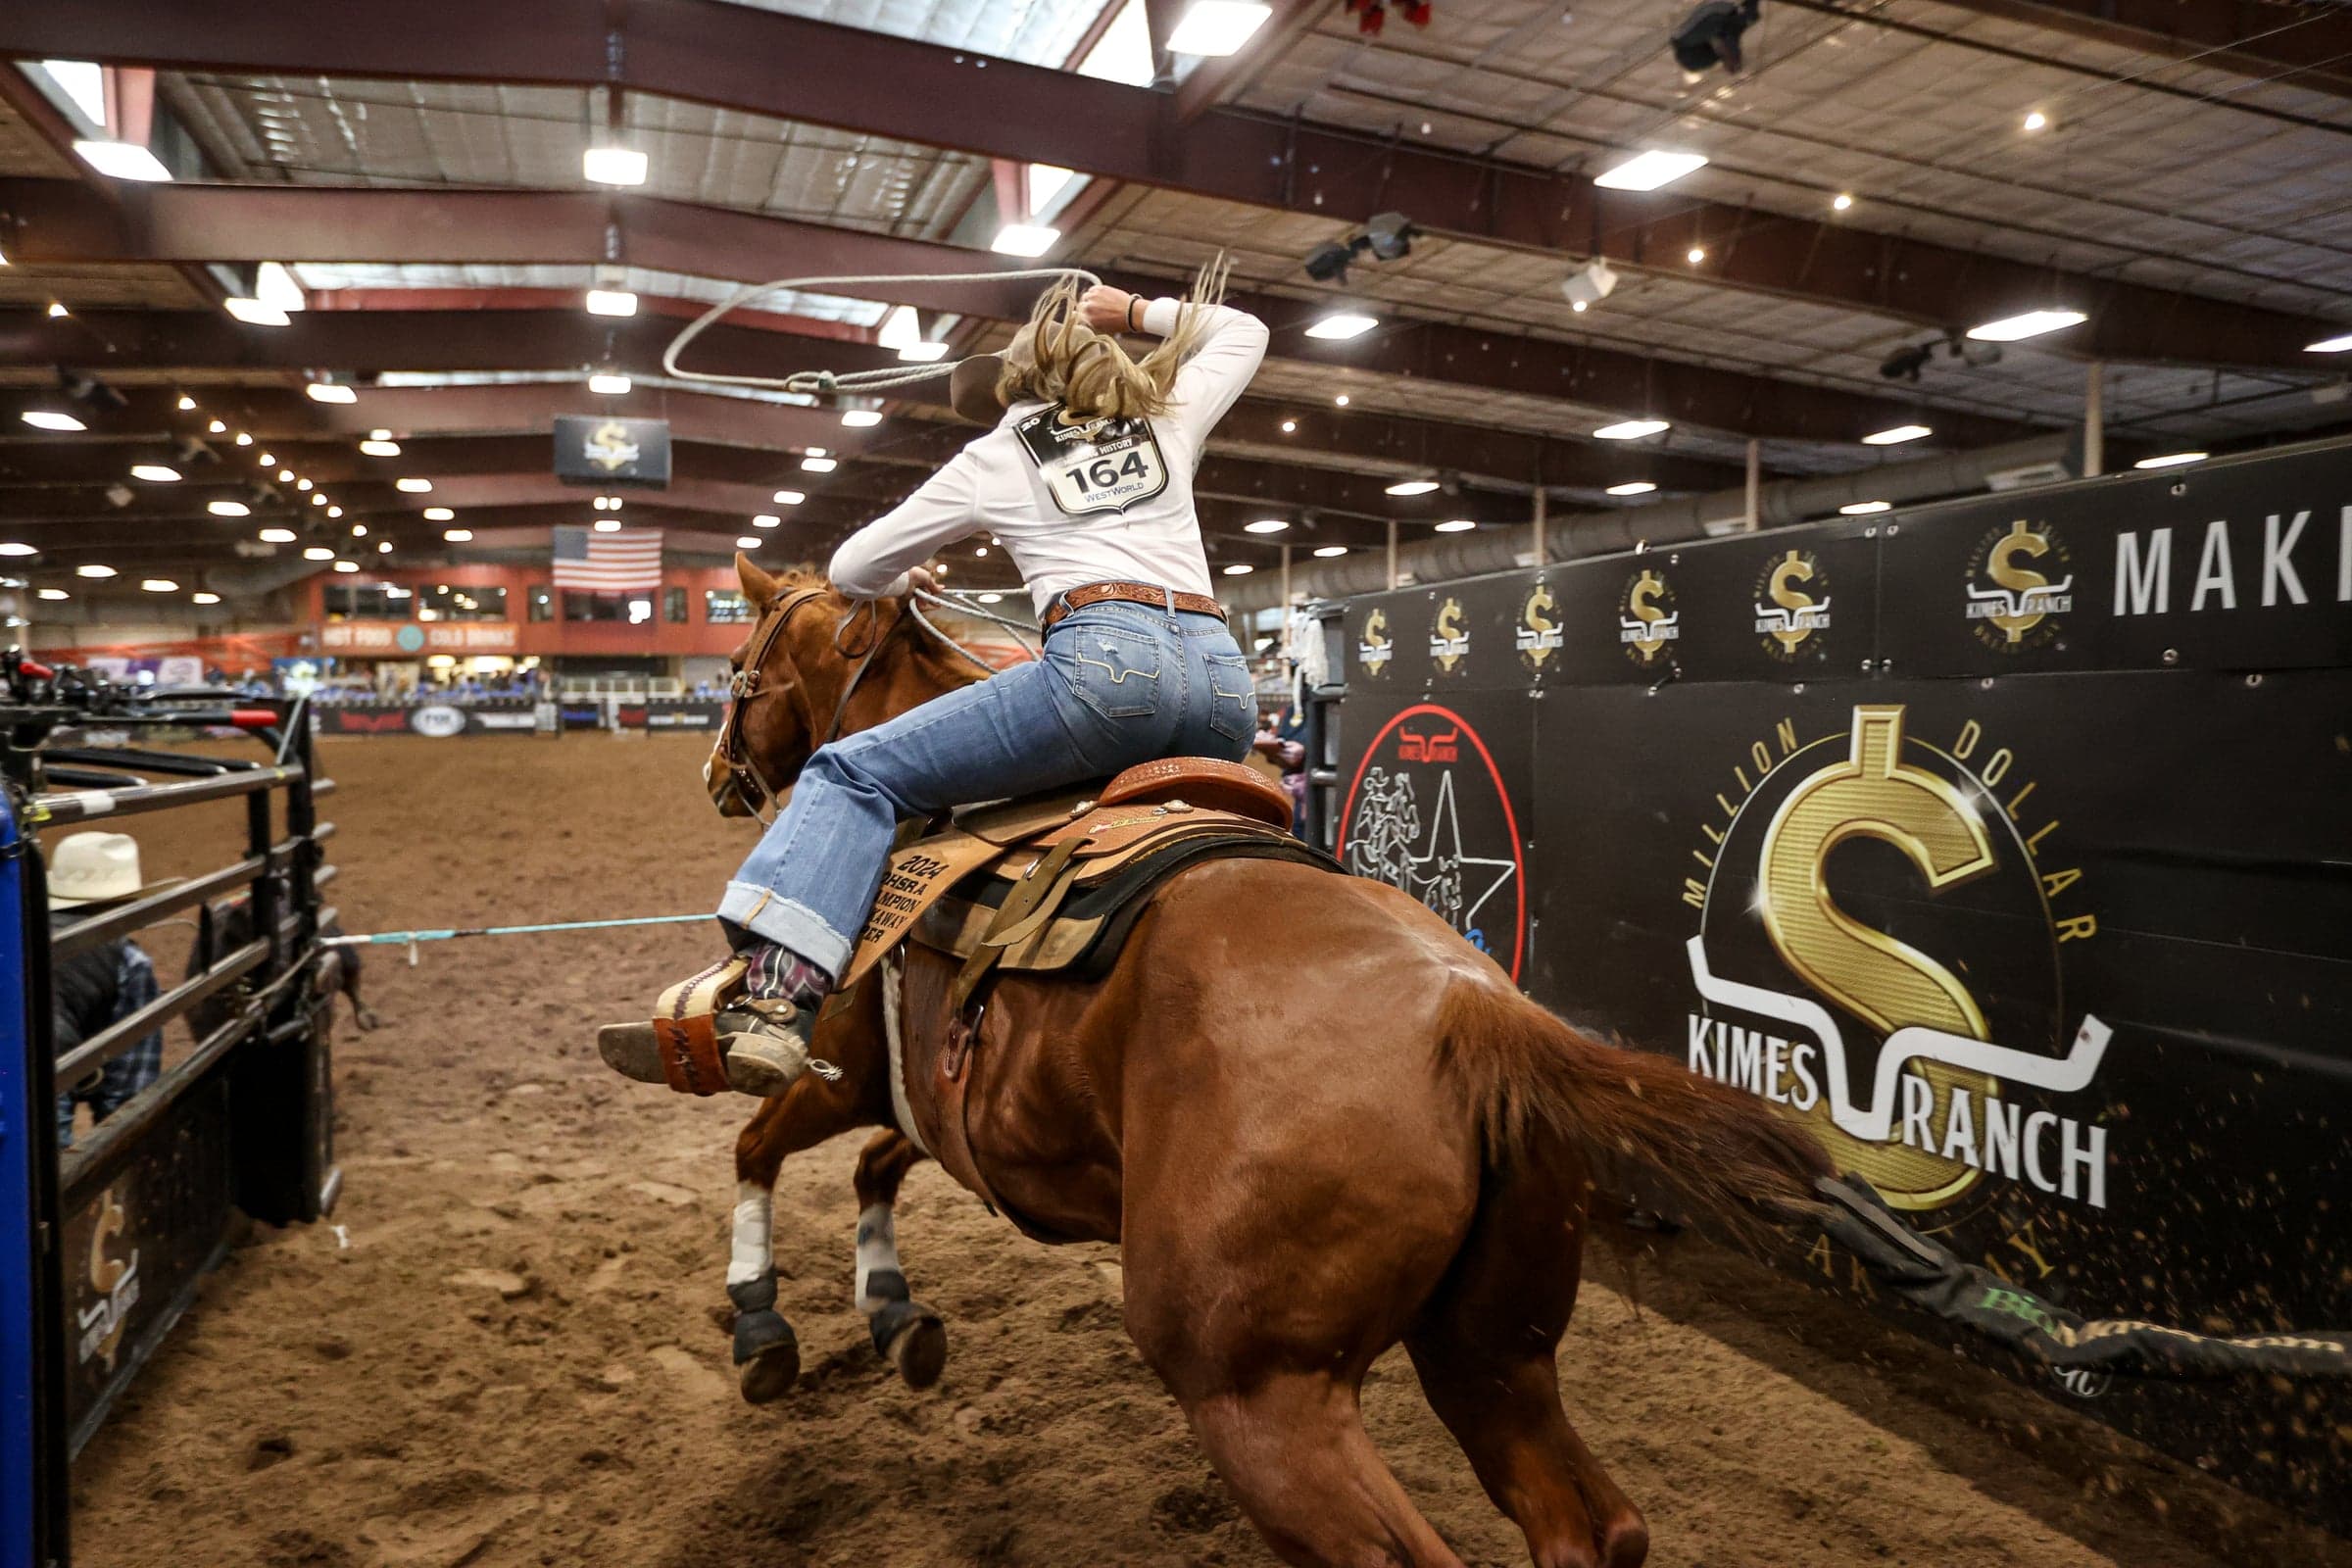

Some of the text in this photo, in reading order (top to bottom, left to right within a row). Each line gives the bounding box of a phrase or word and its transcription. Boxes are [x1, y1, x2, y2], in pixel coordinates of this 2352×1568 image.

[1099, 438, 1133, 455] HISTORY
[1066, 451, 1149, 494] 164
[1682, 717, 2097, 944] MILLION DOLLAR
[898, 856, 949, 880] 2024
[1688, 1013, 2107, 1209] KIMES RANCH
